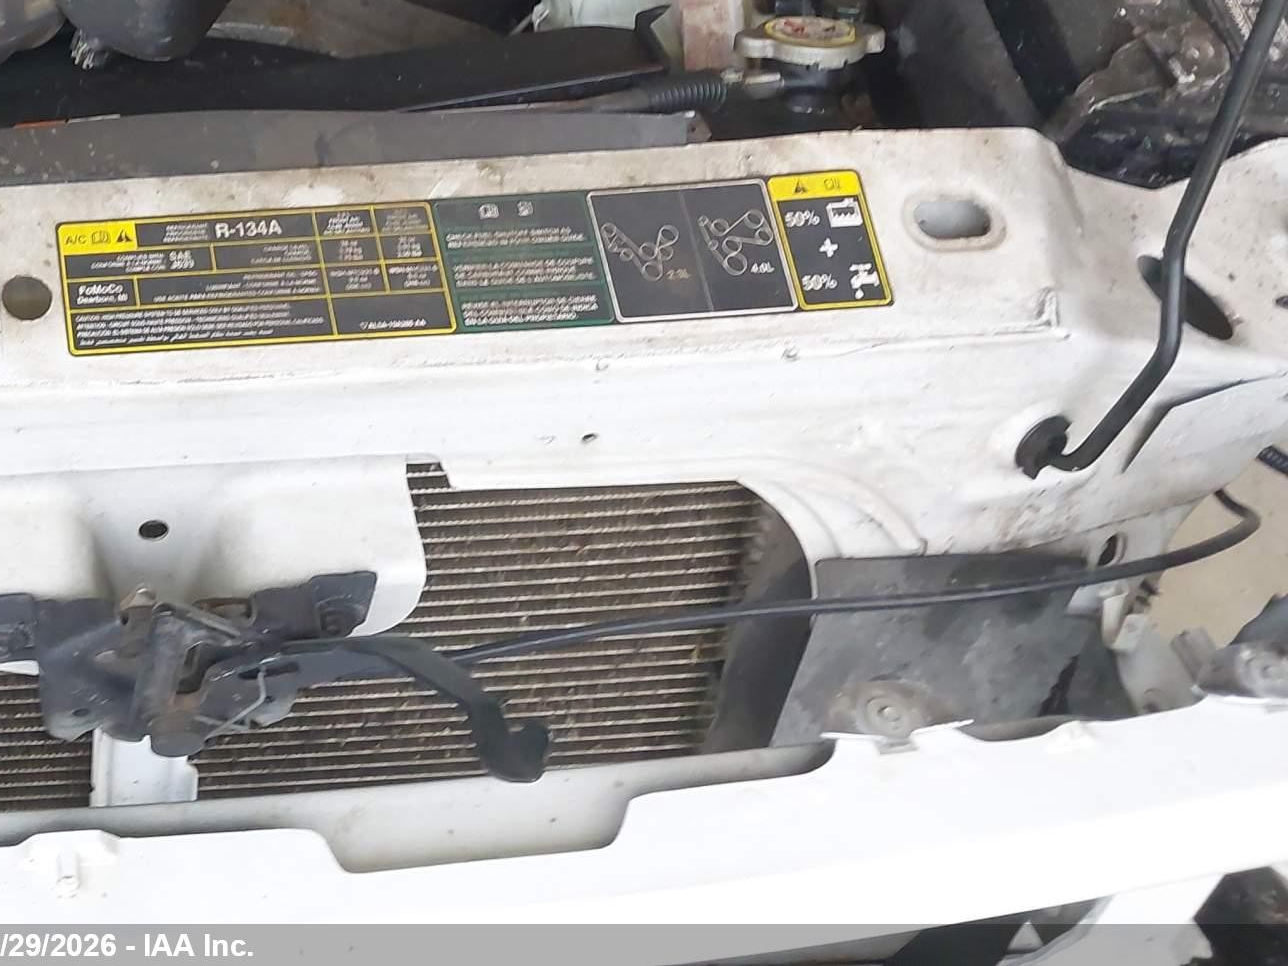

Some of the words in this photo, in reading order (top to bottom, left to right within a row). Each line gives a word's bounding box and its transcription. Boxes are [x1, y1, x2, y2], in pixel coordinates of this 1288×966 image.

[784, 210, 820, 228] 50%
[215, 219, 282, 239] R-134A
[65, 234, 87, 245] A/C
[750, 262, 775, 274] 4.0L
[802, 274, 838, 291] 50%
